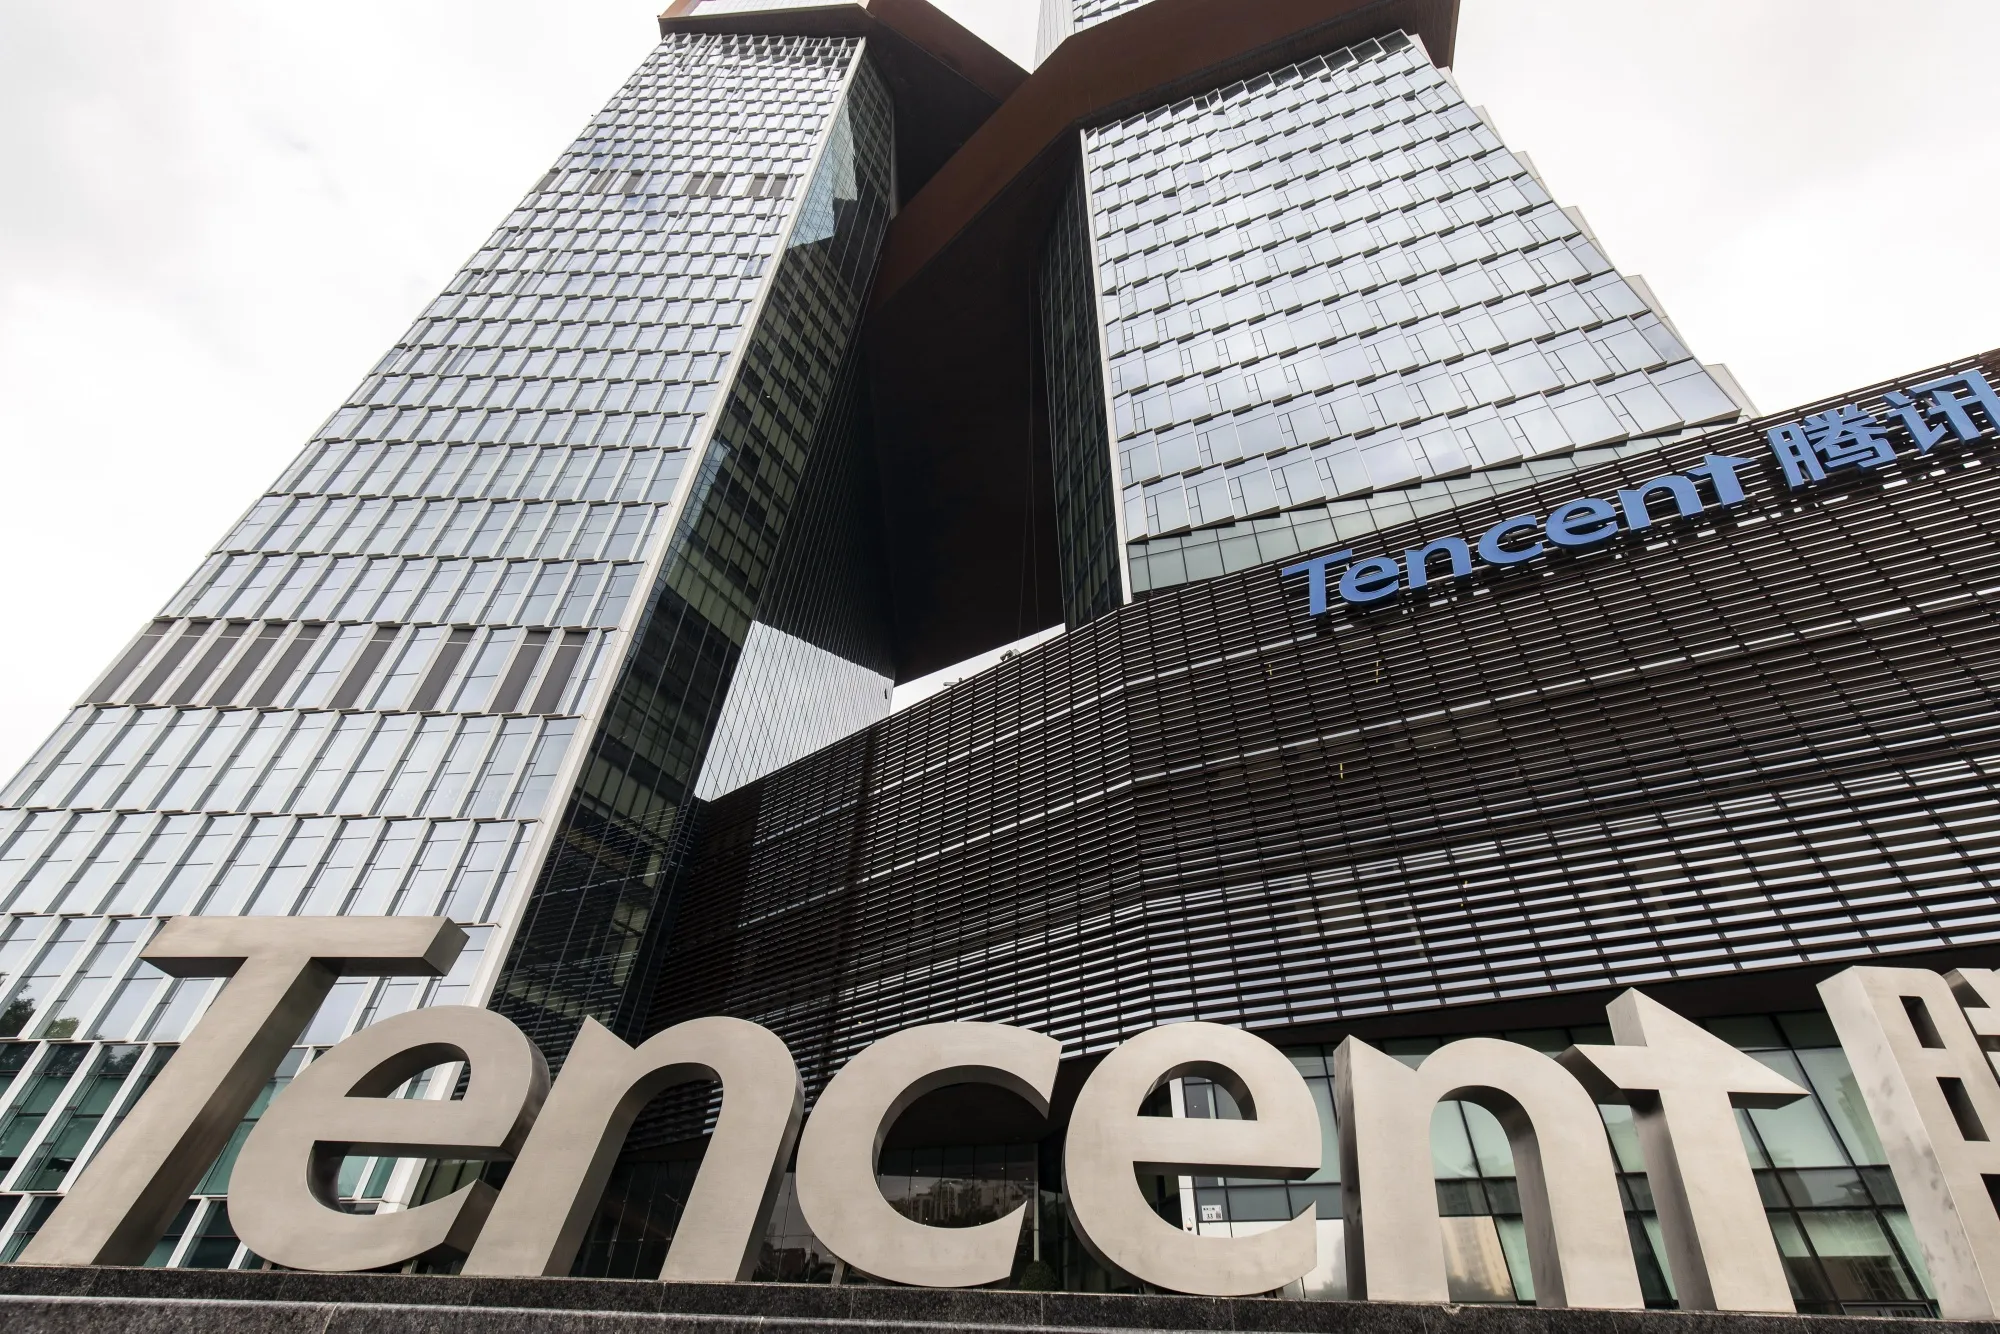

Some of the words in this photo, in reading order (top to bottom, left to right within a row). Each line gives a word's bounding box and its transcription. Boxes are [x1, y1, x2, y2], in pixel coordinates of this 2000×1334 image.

[1281, 453, 1757, 616] Tencent
[1767, 369, 2000, 491] 腾讯
[14, 914, 1812, 1314] Tencent
